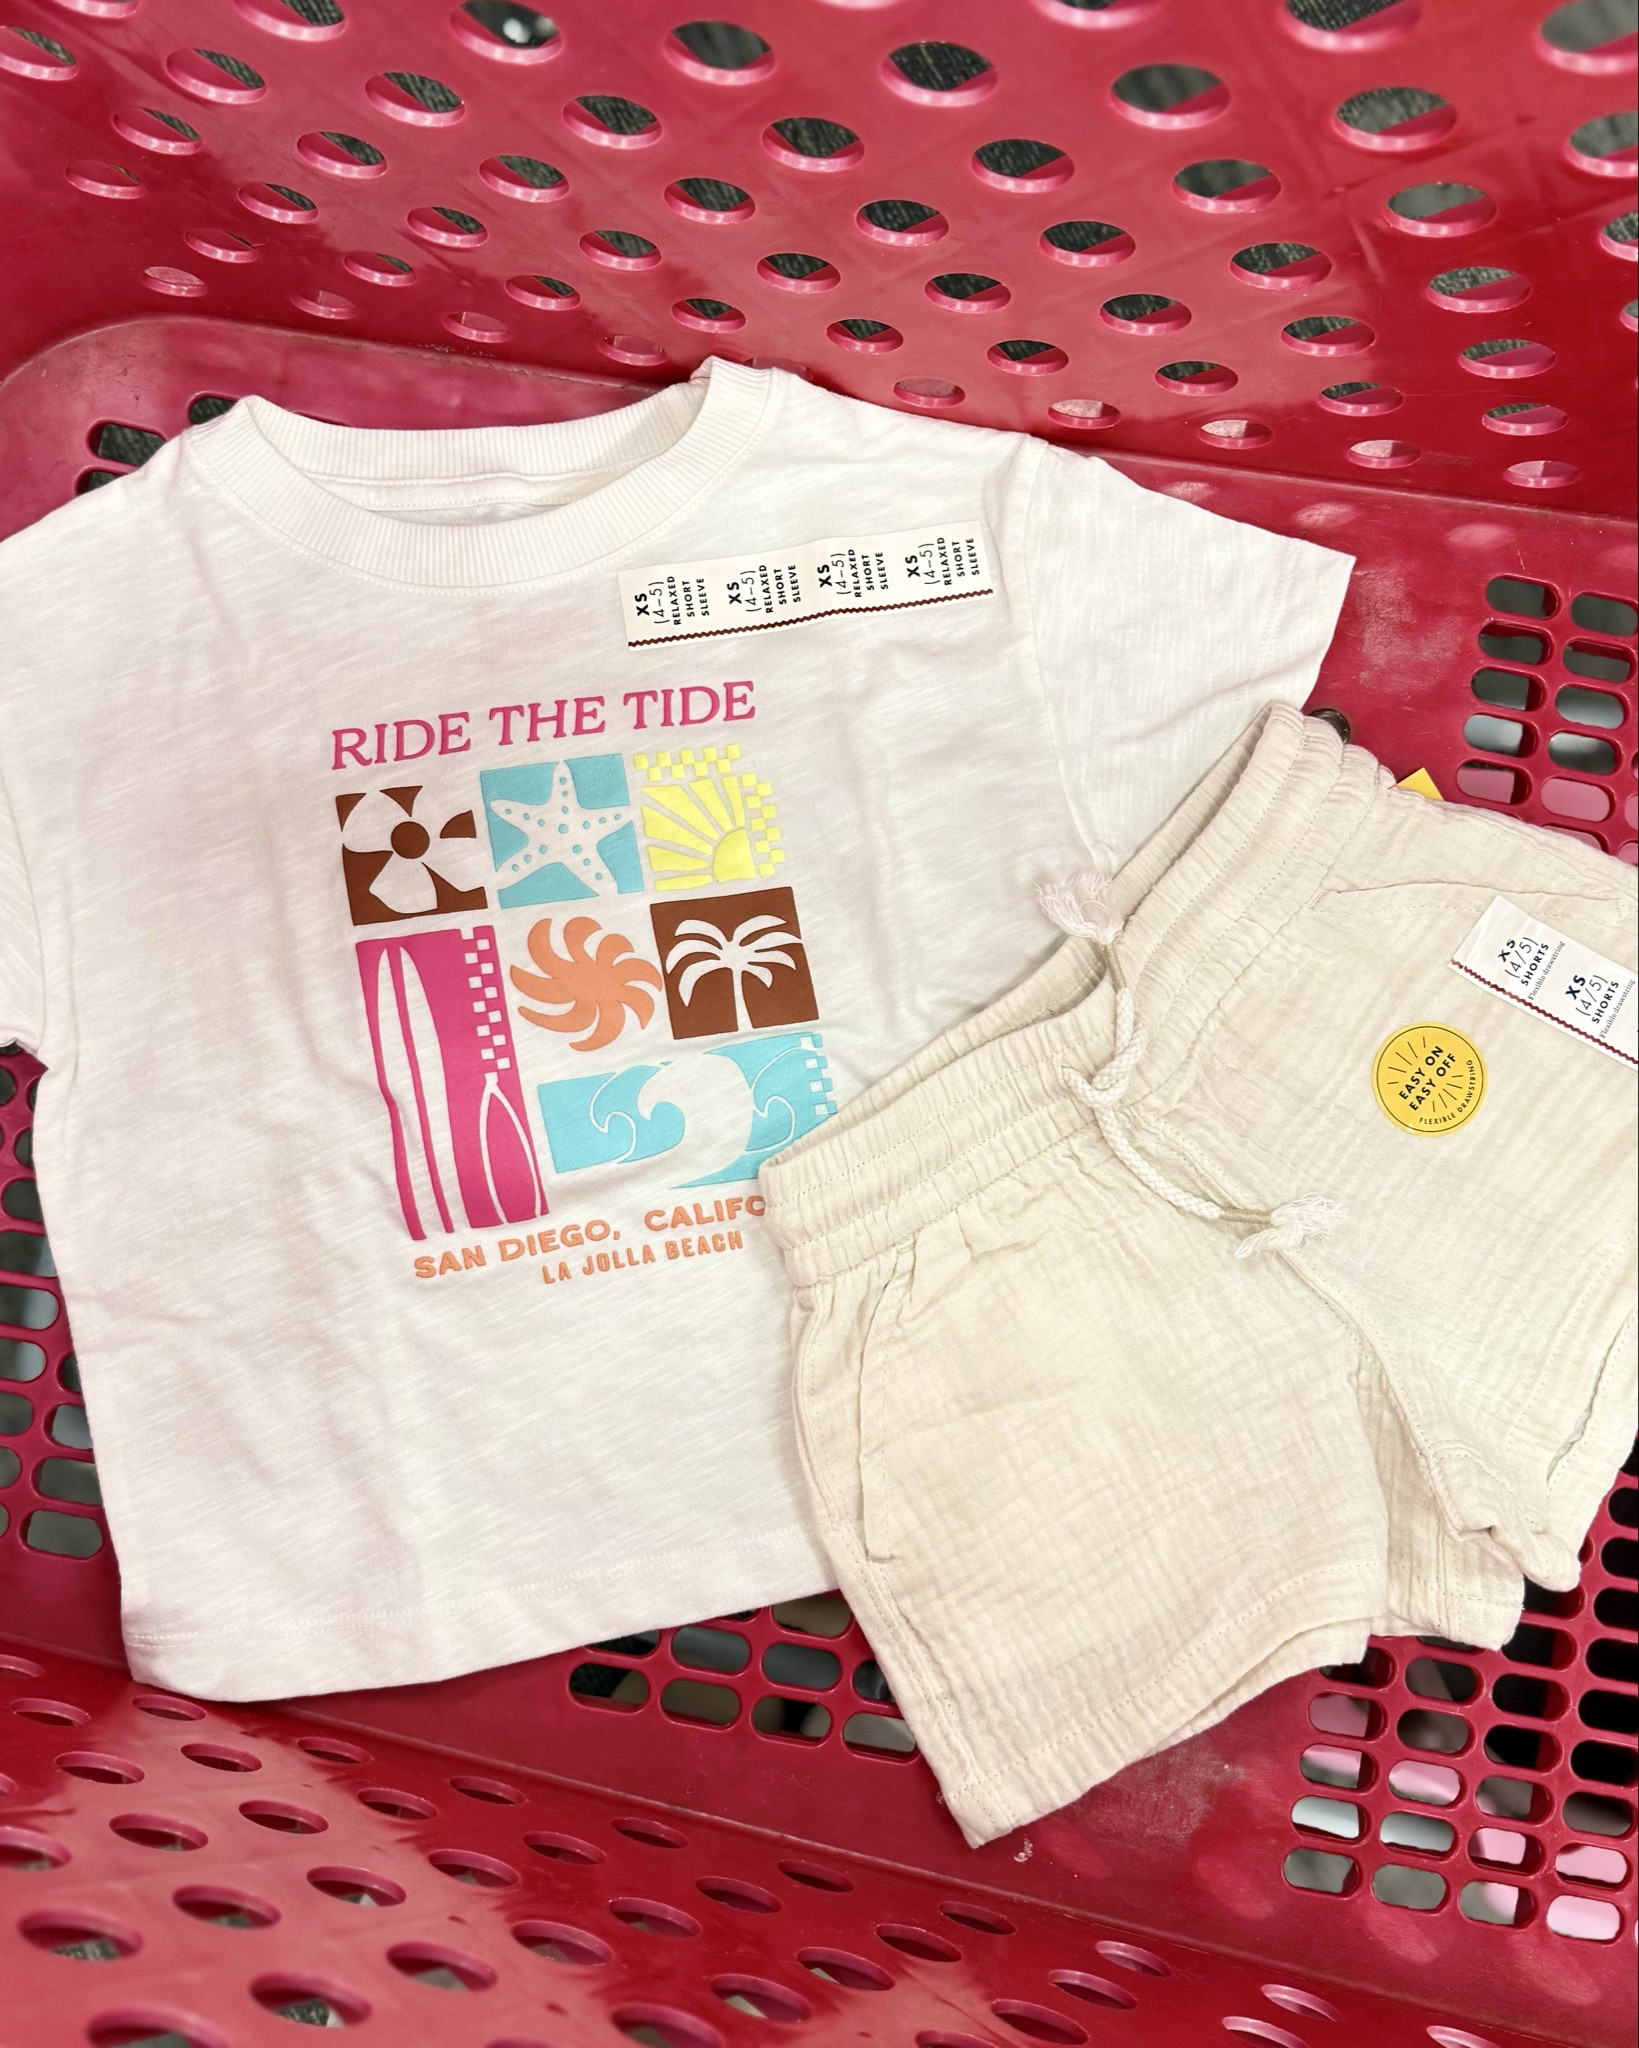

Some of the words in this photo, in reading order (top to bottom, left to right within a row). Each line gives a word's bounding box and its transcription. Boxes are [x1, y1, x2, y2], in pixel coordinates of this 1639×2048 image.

[817, 564, 833, 588] XS
[830, 553, 852, 595] (4-5)
[848, 549, 862, 598] RELAXED
[861, 554, 875, 590] SHORT
[875, 552, 888, 590] SLEEVE
[905, 555, 921, 578] XS
[918, 543, 941, 585] (4-5)
[936, 537, 952, 585] RELAXED
[952, 541, 965, 577] SHORT
[966, 538, 980, 576] SLEEVE
[648, 581, 670, 624] (4-5)
[667, 576, 682, 625] RELAXED
[682, 580, 695, 617] SHORT
[696, 578, 710, 616] SLEEVE
[727, 582, 742, 605] XS
[740, 570, 762, 612] (4-5)
[759, 565, 773, 613] RELAXED
[774, 569, 787, 605] SHORT
[788, 565, 801, 602] SLEEVE
[635, 593, 650, 617] XS
[331, 711, 471, 770] RIDE
[488, 696, 606, 746] THE
[623, 680, 756, 729] TIDE
[1498, 938, 1516, 962] XS
[1505, 937, 1538, 978] (4/5)
[1520, 943, 1549, 986] SHORTS
[1528, 975, 1545, 1000] Flexible
[1543, 941, 1565, 976] drawstring
[1565, 975, 1586, 1000] XS
[1575, 975, 1608, 1016] (4/5)
[1592, 981, 1619, 1024] SHORTS
[1599, 1014, 1616, 1038] Flexible
[1613, 979, 1636, 1013] drawstring
[1398, 1067, 1425, 1100] EASY
[1425, 1045, 1444, 1066] ON
[1408, 1078, 1436, 1111] EASY
[1436, 1053, 1456, 1077] OFF
[1419, 1112, 1456, 1125] FLEXIBLE
[1457, 1060, 1476, 1113] DRAWSTRING
[414, 1245, 486, 1279] SAN
[498, 1219, 621, 1262] DIEGO,
[542, 1262, 572, 1285] LA
[582, 1245, 656, 1276] JOLLA
[665, 1230, 743, 1260] BEACH
